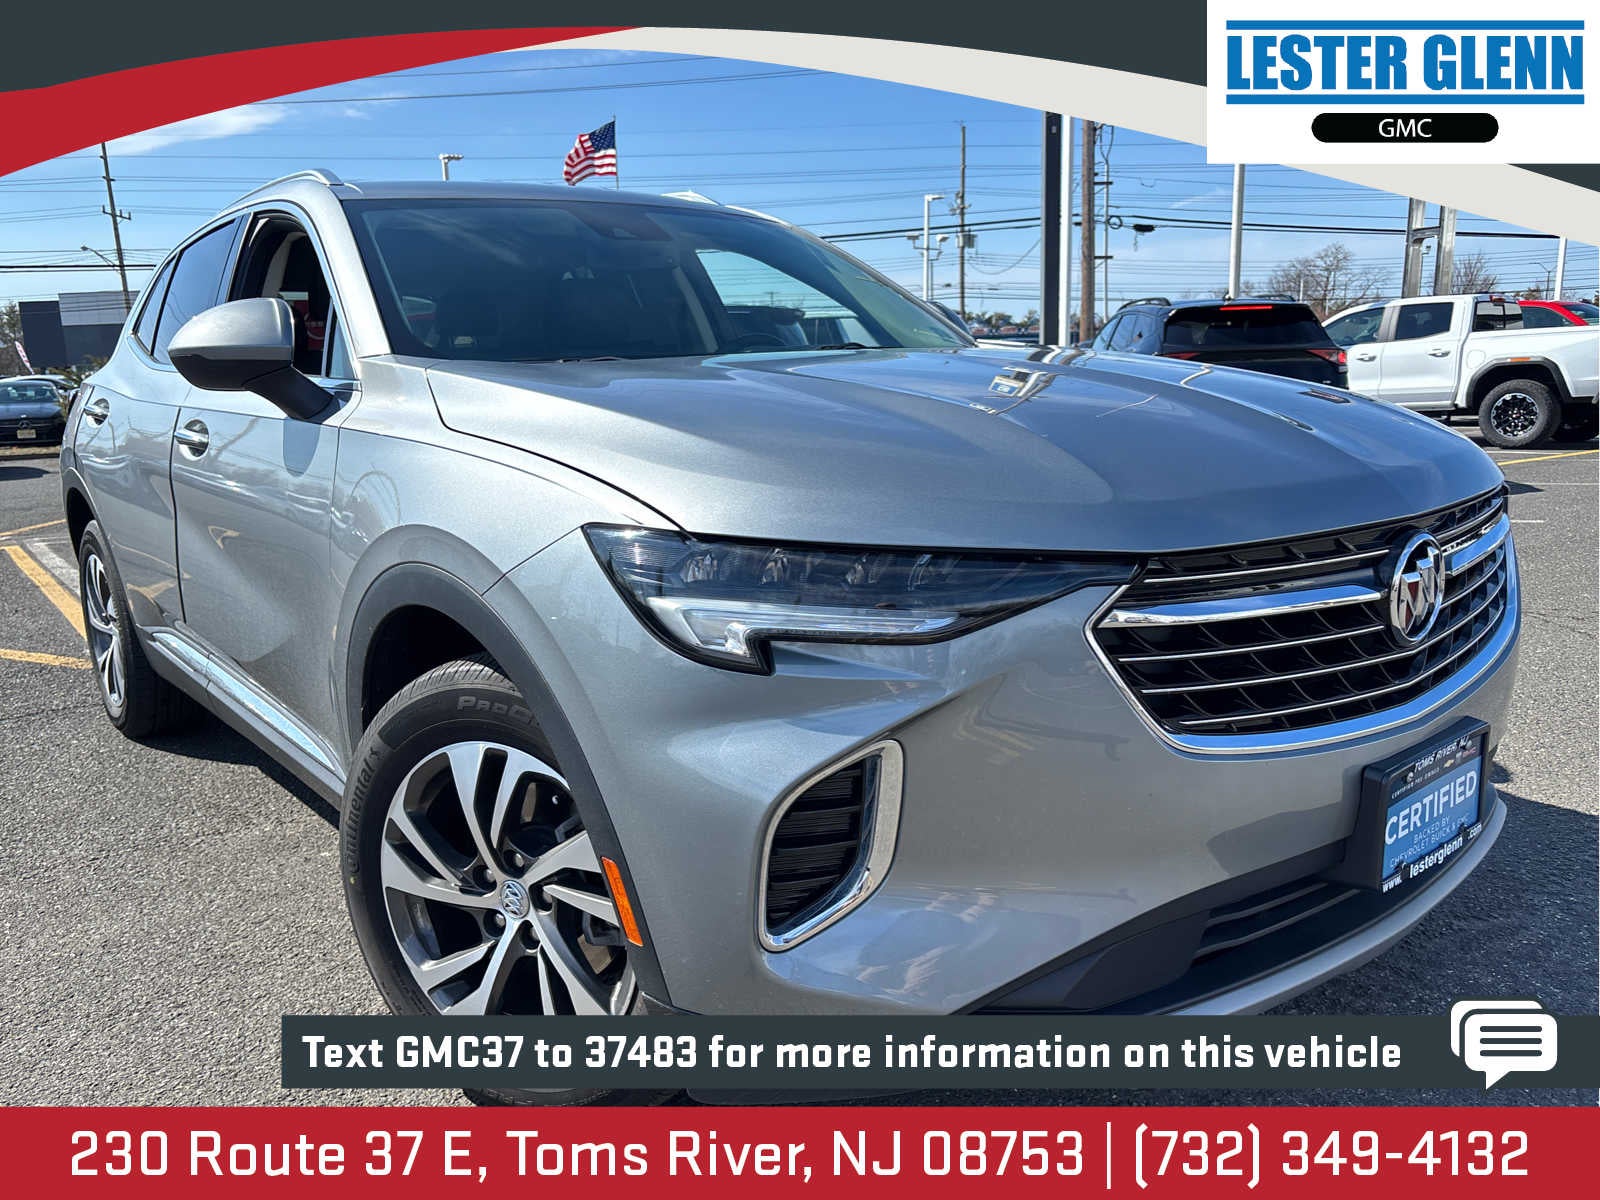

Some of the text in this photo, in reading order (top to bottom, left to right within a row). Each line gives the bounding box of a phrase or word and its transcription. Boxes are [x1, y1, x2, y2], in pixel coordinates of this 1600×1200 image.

[1415, 753, 1435, 773] TOMS
[1384, 770, 1477, 845] CERTIFIED
[1389, 837, 1429, 868] CHEVROLET
[1430, 825, 1451, 844] BUICK
[1413, 815, 1450, 844] BACKED BY
[1382, 823, 1482, 893] www. lesterglenn .com
